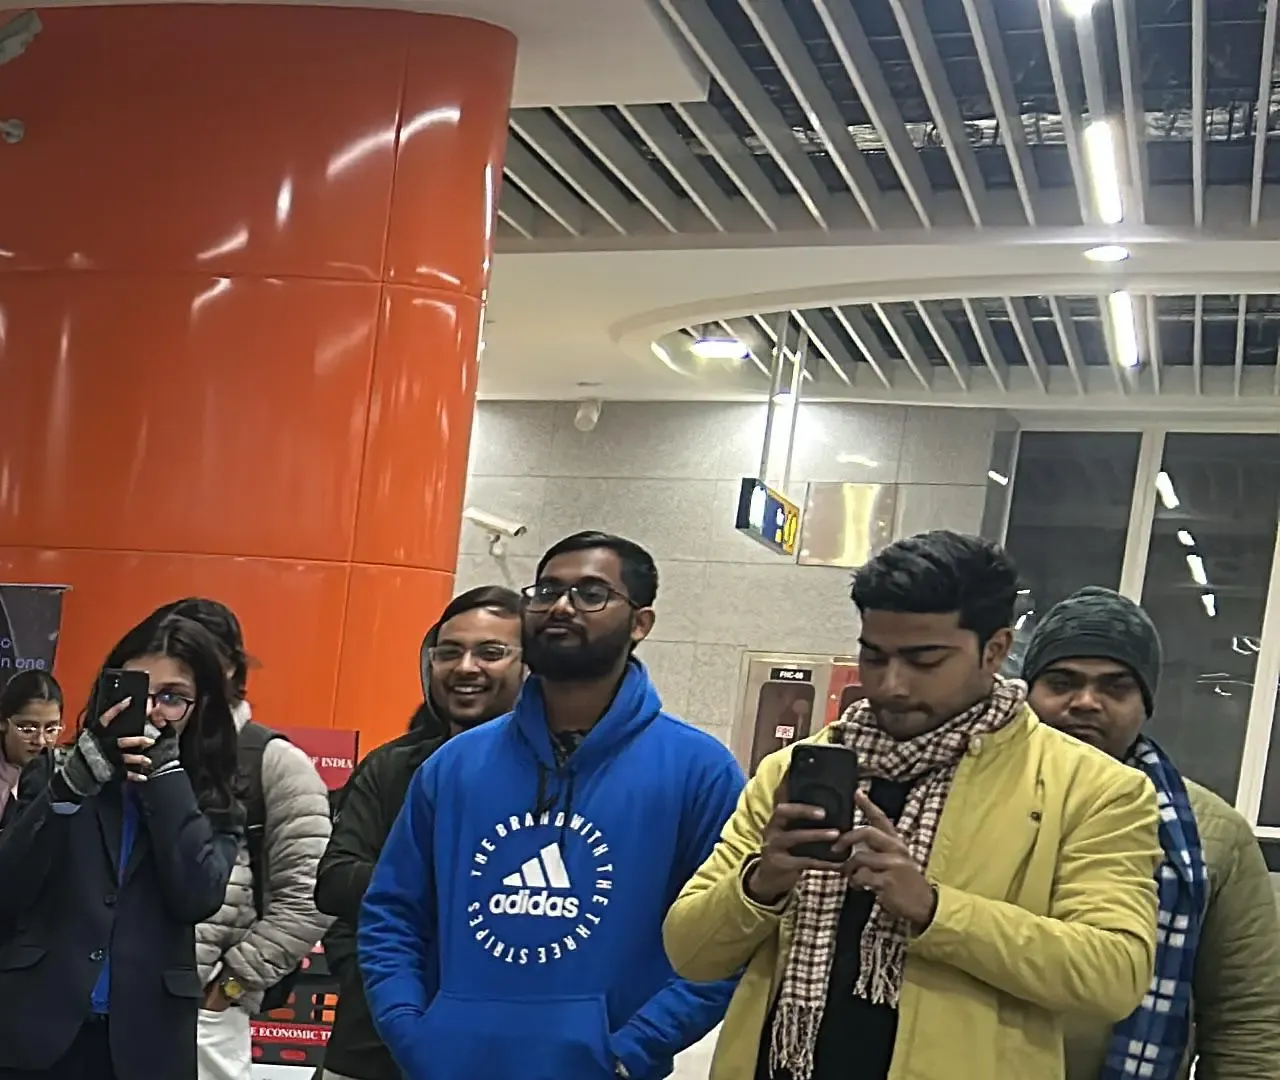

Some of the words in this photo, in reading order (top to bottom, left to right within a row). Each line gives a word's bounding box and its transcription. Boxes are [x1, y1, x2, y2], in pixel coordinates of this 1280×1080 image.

[15, 657, 46, 670] one
[321, 757, 354, 769] INDIA
[489, 889, 580, 918] adidas
[259, 1026, 318, 1040] ECONOMIC
